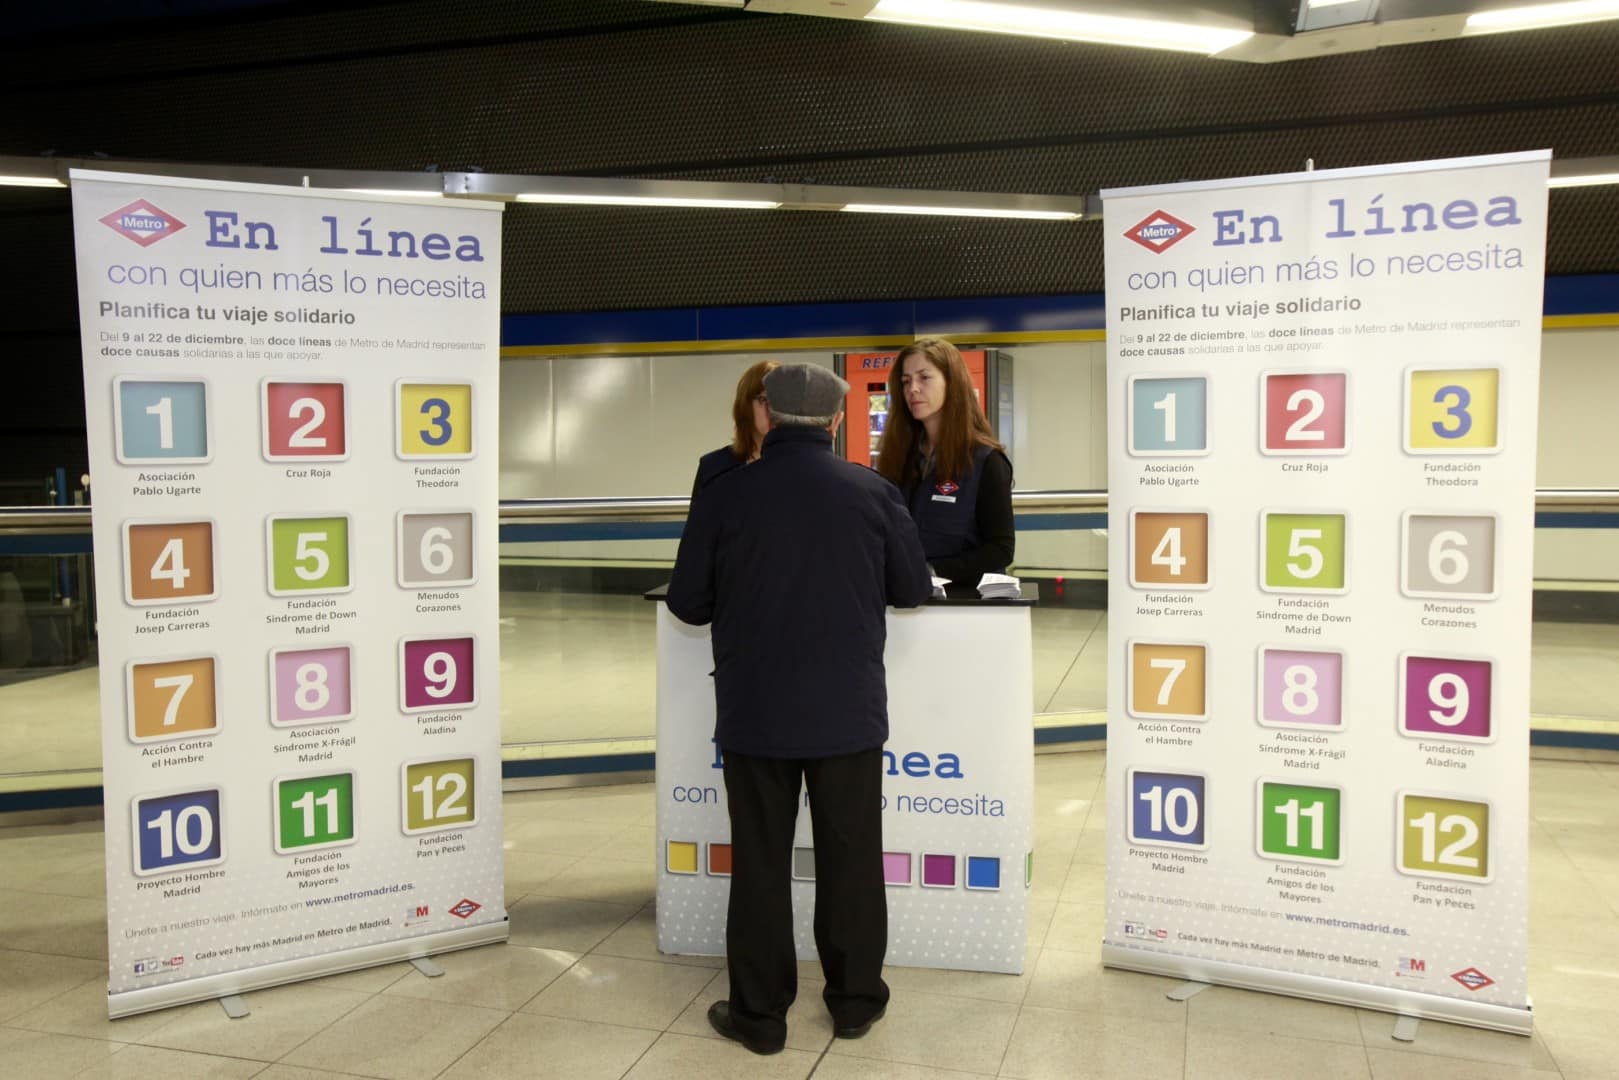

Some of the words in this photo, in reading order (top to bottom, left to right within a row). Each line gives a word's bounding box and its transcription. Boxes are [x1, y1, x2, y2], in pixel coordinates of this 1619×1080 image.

[124, 216, 162, 232] Metro
[1212, 209, 1282, 246] En
[1325, 193, 1523, 239] línea
[204, 210, 278, 250] En
[320, 215, 484, 262] línea
[1140, 227, 1179, 240] Metro
[1127, 270, 1176, 290] con
[1187, 260, 1264, 291] quien
[1276, 255, 1338, 282] más
[1350, 252, 1375, 277] lo
[1387, 243, 1523, 275] necesita
[107, 264, 166, 286] con
[179, 263, 261, 293] quien
[273, 267, 333, 293] más
[344, 269, 366, 294] lo
[377, 275, 485, 299] necesita
[99, 300, 190, 319] Planifica
[196, 305, 215, 320] tu
[222, 306, 268, 325] viaje
[274, 308, 355, 324] solidario
[1120, 304, 1195, 321] Planifica
[1201, 303, 1219, 317] tu
[1225, 300, 1269, 319] viaje
[1275, 295, 1361, 314] solidario
[862, 357, 896, 368] REF
[1153, 392, 1176, 442] 1
[1285, 389, 1325, 440] 2
[1432, 385, 1472, 439] 3
[146, 397, 173, 448] 1
[288, 397, 326, 447] 2
[419, 398, 452, 446] 3
[286, 469, 307, 477] Cruz
[310, 469, 331, 479] Roja
[1144, 463, 1194, 472] Asociación
[1281, 463, 1303, 471] Cruz
[1306, 463, 1328, 473] Roja
[138, 472, 195, 481] Asociación
[416, 479, 458, 488] Theodora
[1139, 476, 1165, 485] Pablo
[1167, 477, 1199, 487] Ugarte
[1425, 477, 1478, 486] Theodora
[133, 486, 163, 495] Pablo
[166, 486, 201, 496] Ugarte
[294, 532, 329, 580] 5
[420, 526, 453, 574] 6
[1151, 527, 1186, 575] 4
[1287, 528, 1323, 579] 5
[1428, 530, 1468, 584] 6
[150, 538, 190, 588] 4
[417, 591, 459, 600] Menudos
[315, 611, 327, 620] de
[329, 611, 356, 619] Down
[415, 604, 461, 613] Corazones
[1136, 607, 1161, 616] Josep
[1163, 607, 1203, 616] Carreras
[1423, 602, 1475, 614] Menudos
[1306, 612, 1318, 621] de
[1321, 613, 1351, 622] Down
[1420, 617, 1477, 628] Corazones
[135, 625, 164, 634] Josep
[167, 621, 210, 631] Carreras
[295, 624, 330, 634] Madrid
[1285, 625, 1321, 635] Madrid
[423, 651, 456, 698] 9
[1150, 658, 1186, 705] 7
[294, 662, 330, 711] 8
[1282, 665, 1319, 715] 8
[154, 674, 193, 725] 7
[1428, 672, 1469, 726] 9
[289, 726, 339, 738] Asociación
[423, 726, 456, 735] Aladina
[1137, 722, 1167, 732] Acción
[1170, 724, 1201, 734] Contra
[273, 742, 319, 753] Síndrome
[321, 736, 356, 747] X-Frágil
[1145, 735, 1153, 743] el
[1156, 736, 1192, 746] Hambre
[1276, 732, 1329, 745] Asociación
[141, 744, 176, 756] Acción
[178, 741, 212, 751] Contra
[298, 751, 332, 762] Madrid
[1259, 744, 1305, 756] Síndrome
[151, 759, 160, 768] el
[163, 754, 204, 766] Hambre
[1283, 759, 1319, 770] Madrid
[412, 772, 467, 820] 12
[672, 786, 717, 804] con
[291, 788, 338, 837] 11
[897, 793, 1004, 816] necesita
[1139, 785, 1198, 835] 10
[147, 805, 213, 858] 10
[1274, 799, 1324, 850] 11
[1409, 811, 1478, 868] 12
[416, 850, 432, 858] Pan
[435, 848, 441, 857] y
[441, 844, 466, 853] Peces
[1129, 848, 1168, 859] Proyecto
[1171, 851, 1208, 864] Hombre
[286, 868, 320, 878] Amigos
[323, 864, 334, 872] de
[1151, 862, 1184, 874] Madrid
[136, 877, 182, 890] Proyecto
[185, 870, 225, 882] Hombre
[298, 877, 339, 888] Mayores
[163, 885, 200, 898] Madrid
